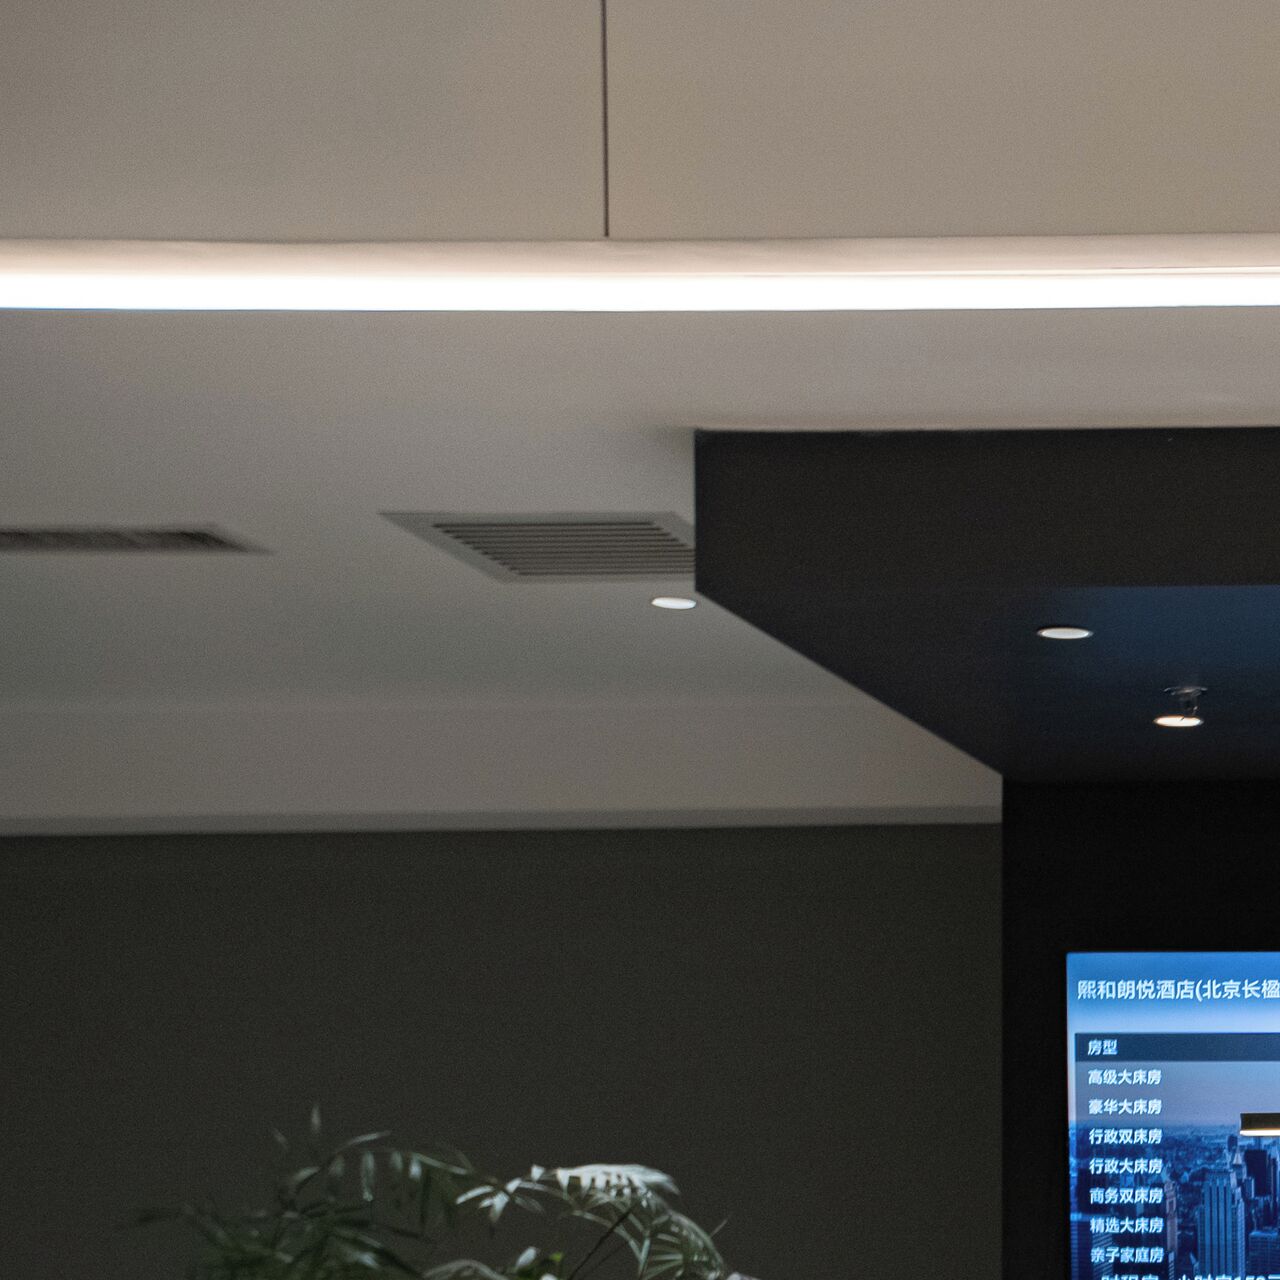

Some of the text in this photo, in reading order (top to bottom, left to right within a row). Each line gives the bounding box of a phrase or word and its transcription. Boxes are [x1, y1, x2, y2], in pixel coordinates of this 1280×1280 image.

[1087, 1039, 1118, 1056] 房型
[1087, 1069, 1162, 1086] 高级大床房
[1088, 1098, 1163, 1115] 豪华大床房
[1088, 1128, 1163, 1145] 行政双床房
[1089, 1158, 1163, 1175] 行政大床房
[1090, 1187, 1163, 1204] 商务双床房
[1090, 1217, 1164, 1234] 精选大床房
[1090, 1247, 1165, 1264] 亲子家庭房
